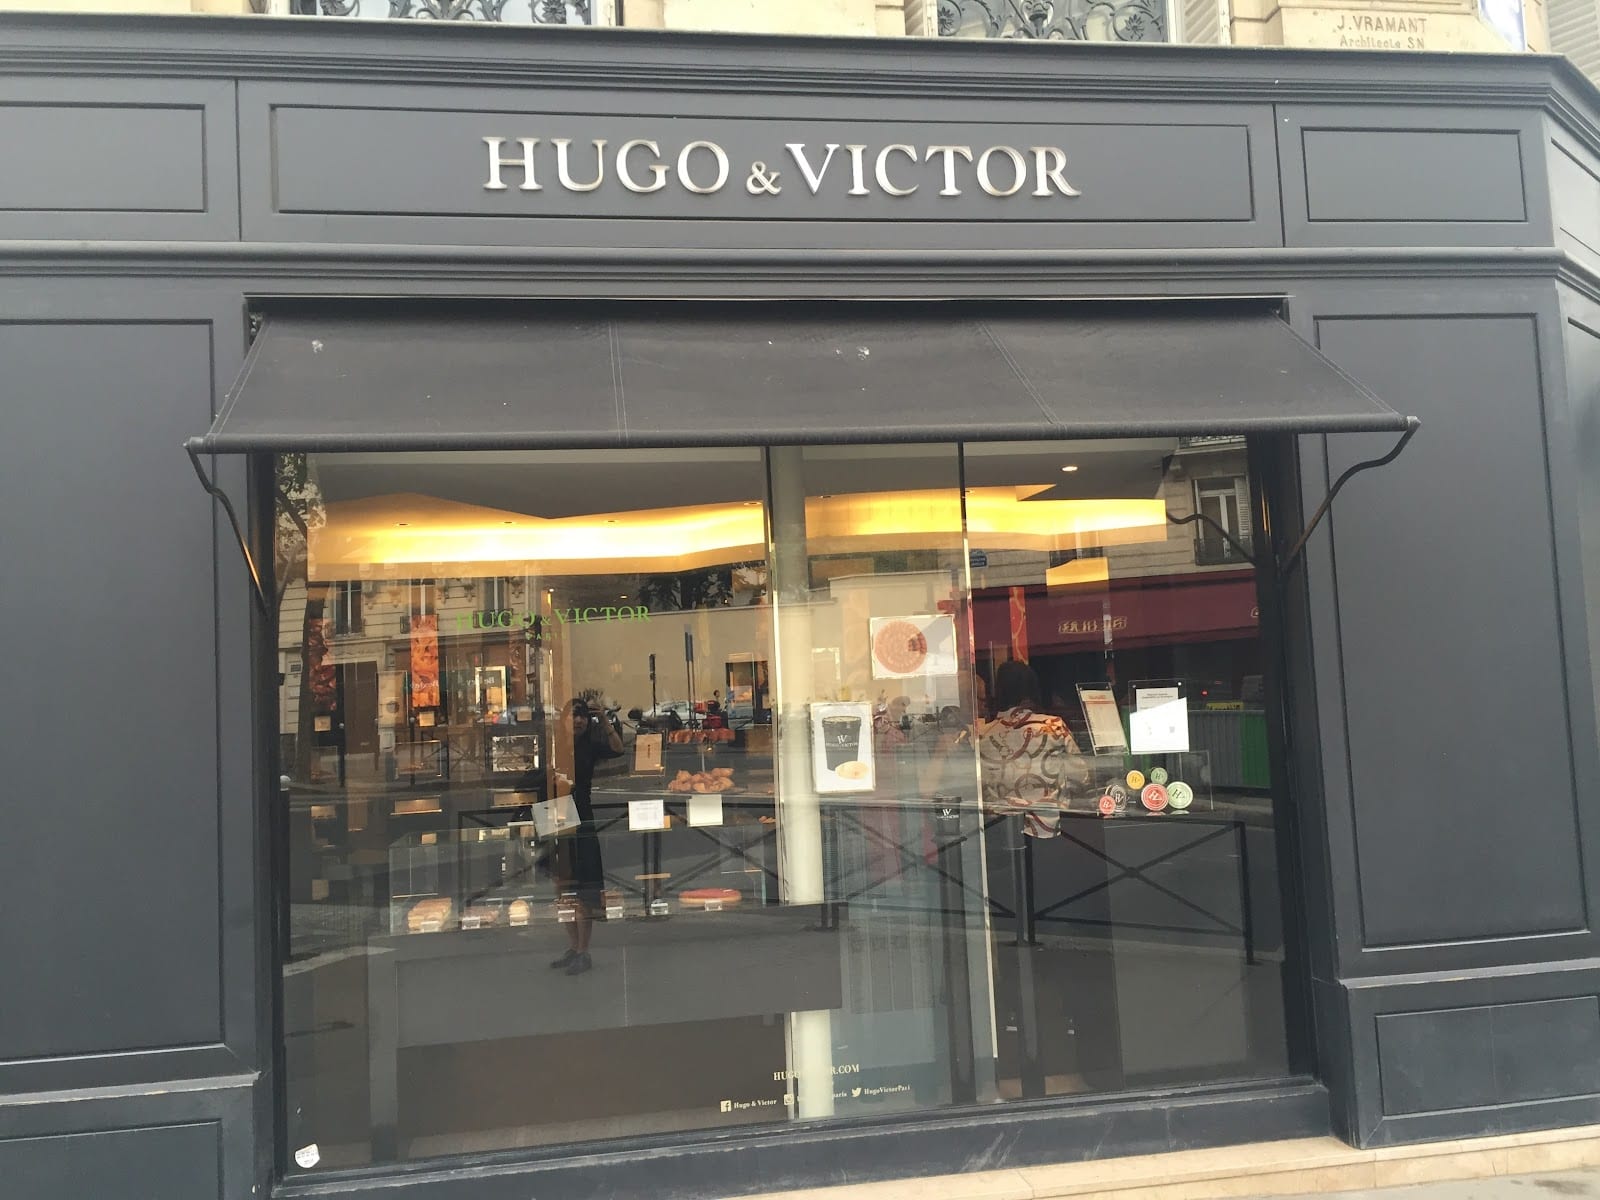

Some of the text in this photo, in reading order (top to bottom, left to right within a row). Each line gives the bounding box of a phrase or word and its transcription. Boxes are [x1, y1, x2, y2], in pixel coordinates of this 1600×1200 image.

[482, 136, 1082, 197] HUGO & VICTOR
[456, 608, 536, 630] HUGO
[553, 605, 652, 625] VICTOR
